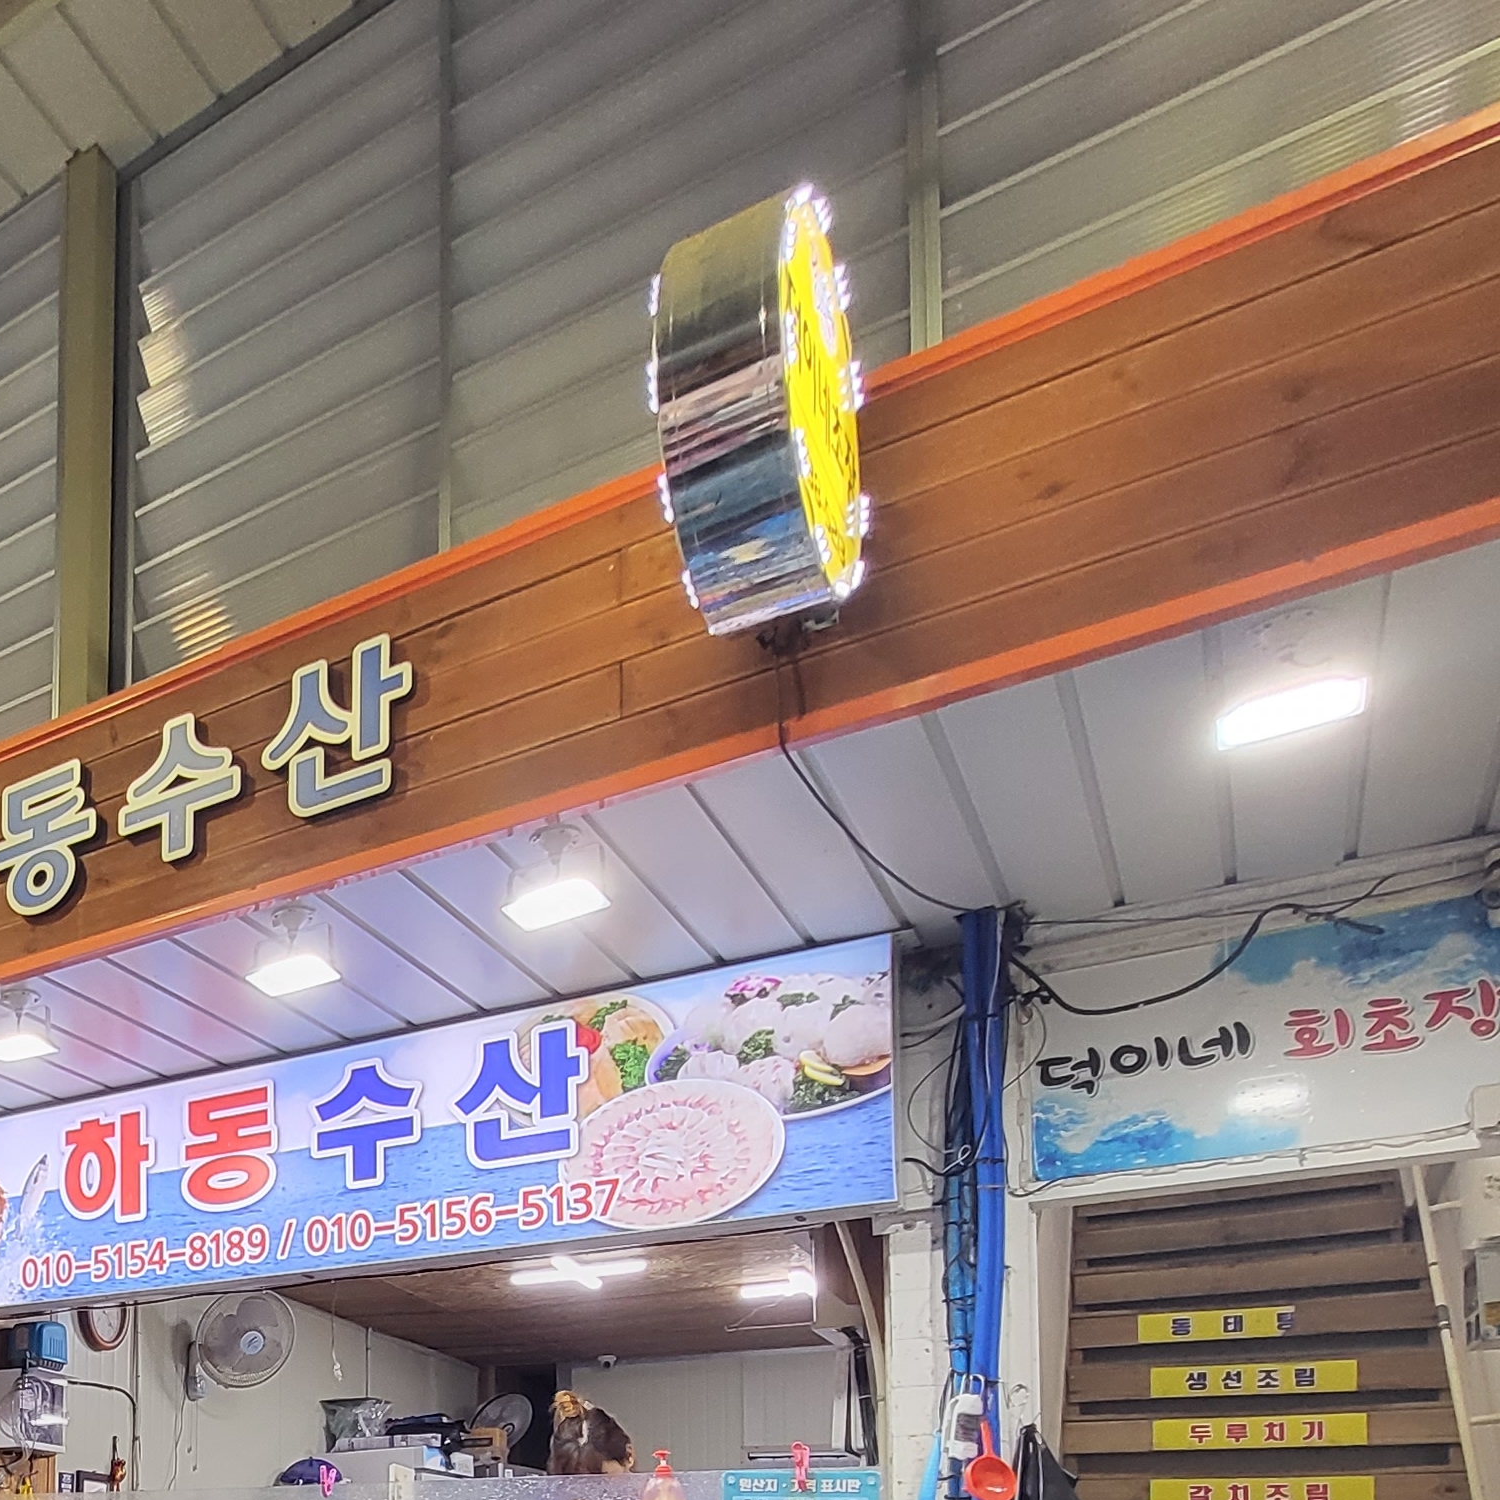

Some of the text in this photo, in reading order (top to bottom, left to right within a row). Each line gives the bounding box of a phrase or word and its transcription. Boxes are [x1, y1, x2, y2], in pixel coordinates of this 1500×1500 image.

[1036, 979, 1500, 1095] 덕이네 회초장
[63, 1025, 583, 1218] 하동수산
[22, 1226, 268, 1289] 010-5154-8189
[306, 1179, 621, 1255] 010-5156-5137
[1185, 1367, 1317, 1391] 생선조림
[1189, 1420, 1326, 1443] 두루치기
[739, 1478, 778, 1492] 원산지
[820, 1478, 862, 1493] 표시판
